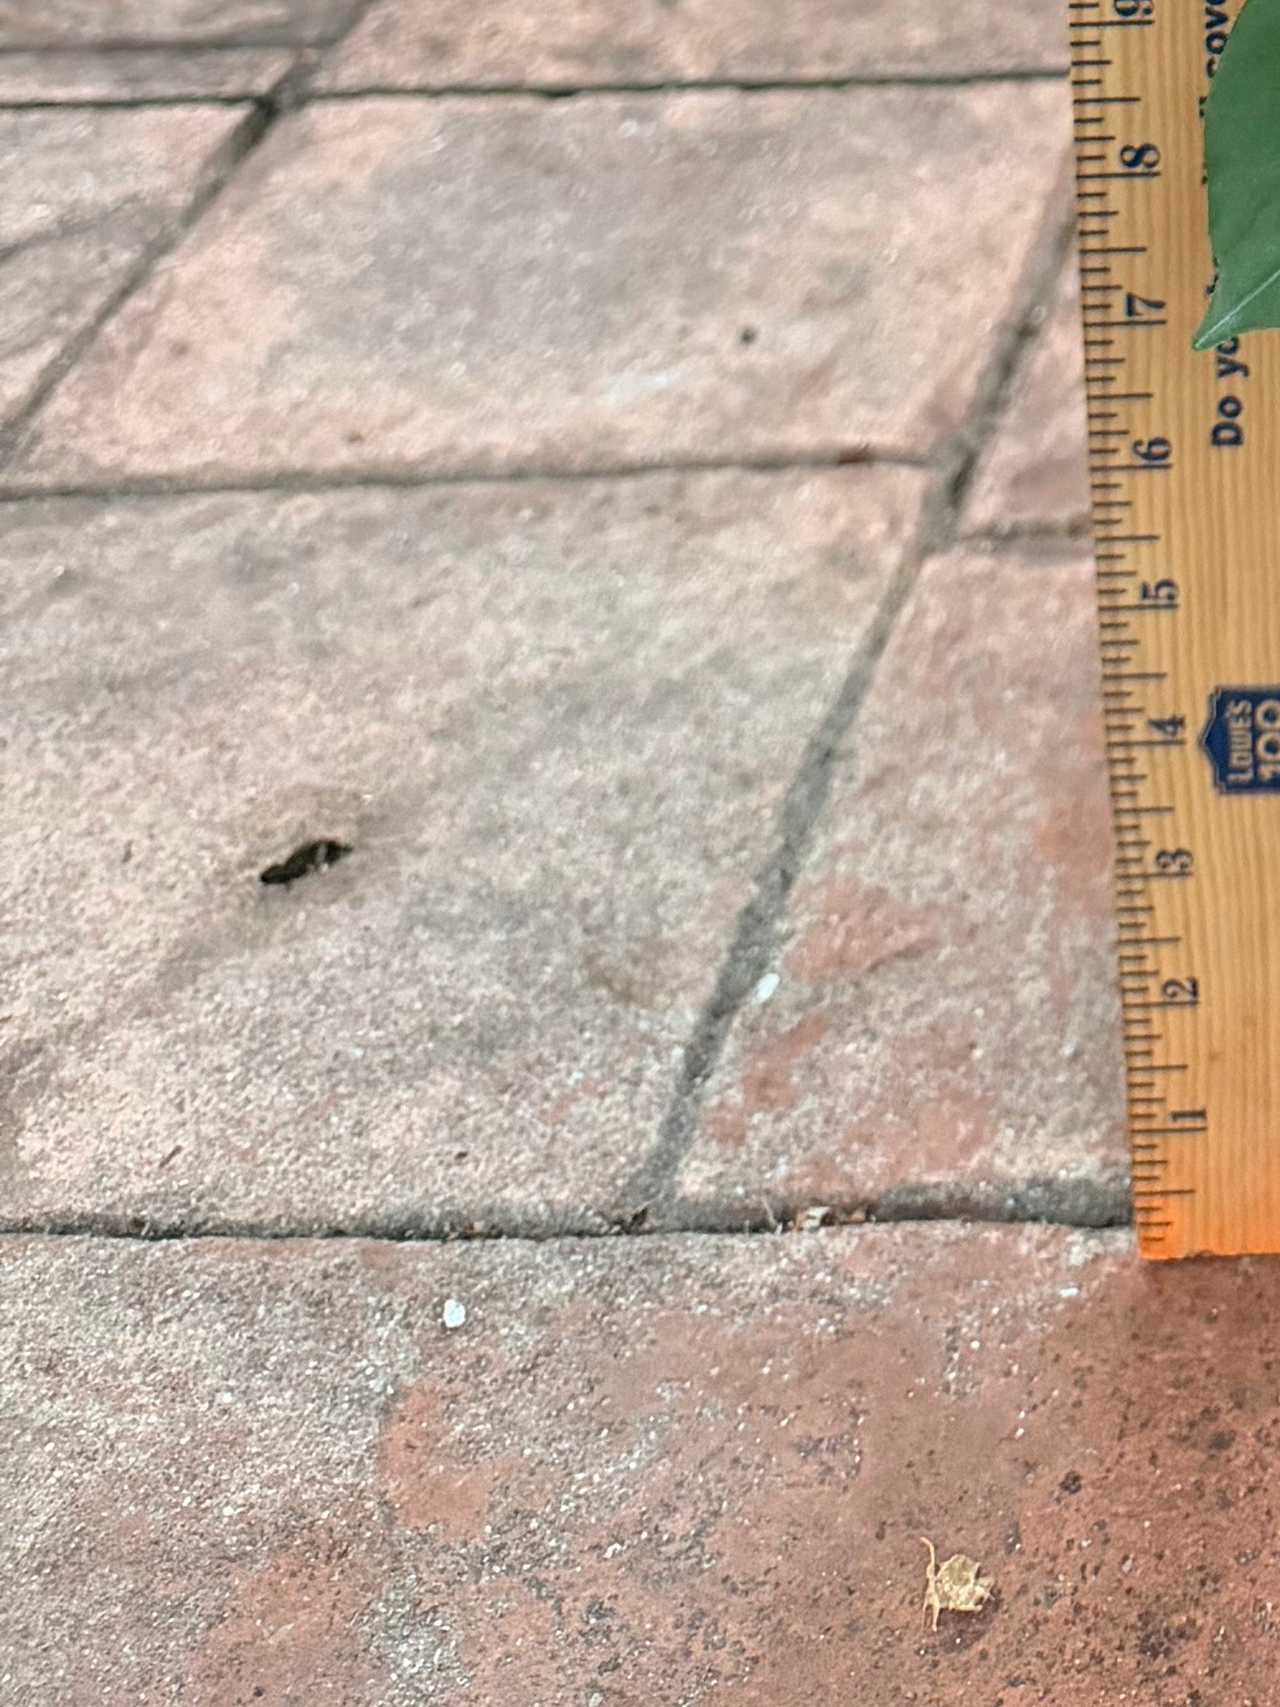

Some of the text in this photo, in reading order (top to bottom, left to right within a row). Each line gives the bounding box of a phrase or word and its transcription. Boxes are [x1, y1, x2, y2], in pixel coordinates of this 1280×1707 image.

[1119, 143, 1161, 169] 8
[1126, 292, 1167, 318] 7
[1217, 336, 1250, 378] yo
[1211, 395, 1243, 447] Do
[1132, 436, 1172, 462] 6
[1140, 578, 1180, 603] 5
[1147, 714, 1186, 737] 4
[1155, 847, 1193, 871] 3
[1161, 976, 1200, 999] 2
[1171, 1108, 1207, 1123] 1
